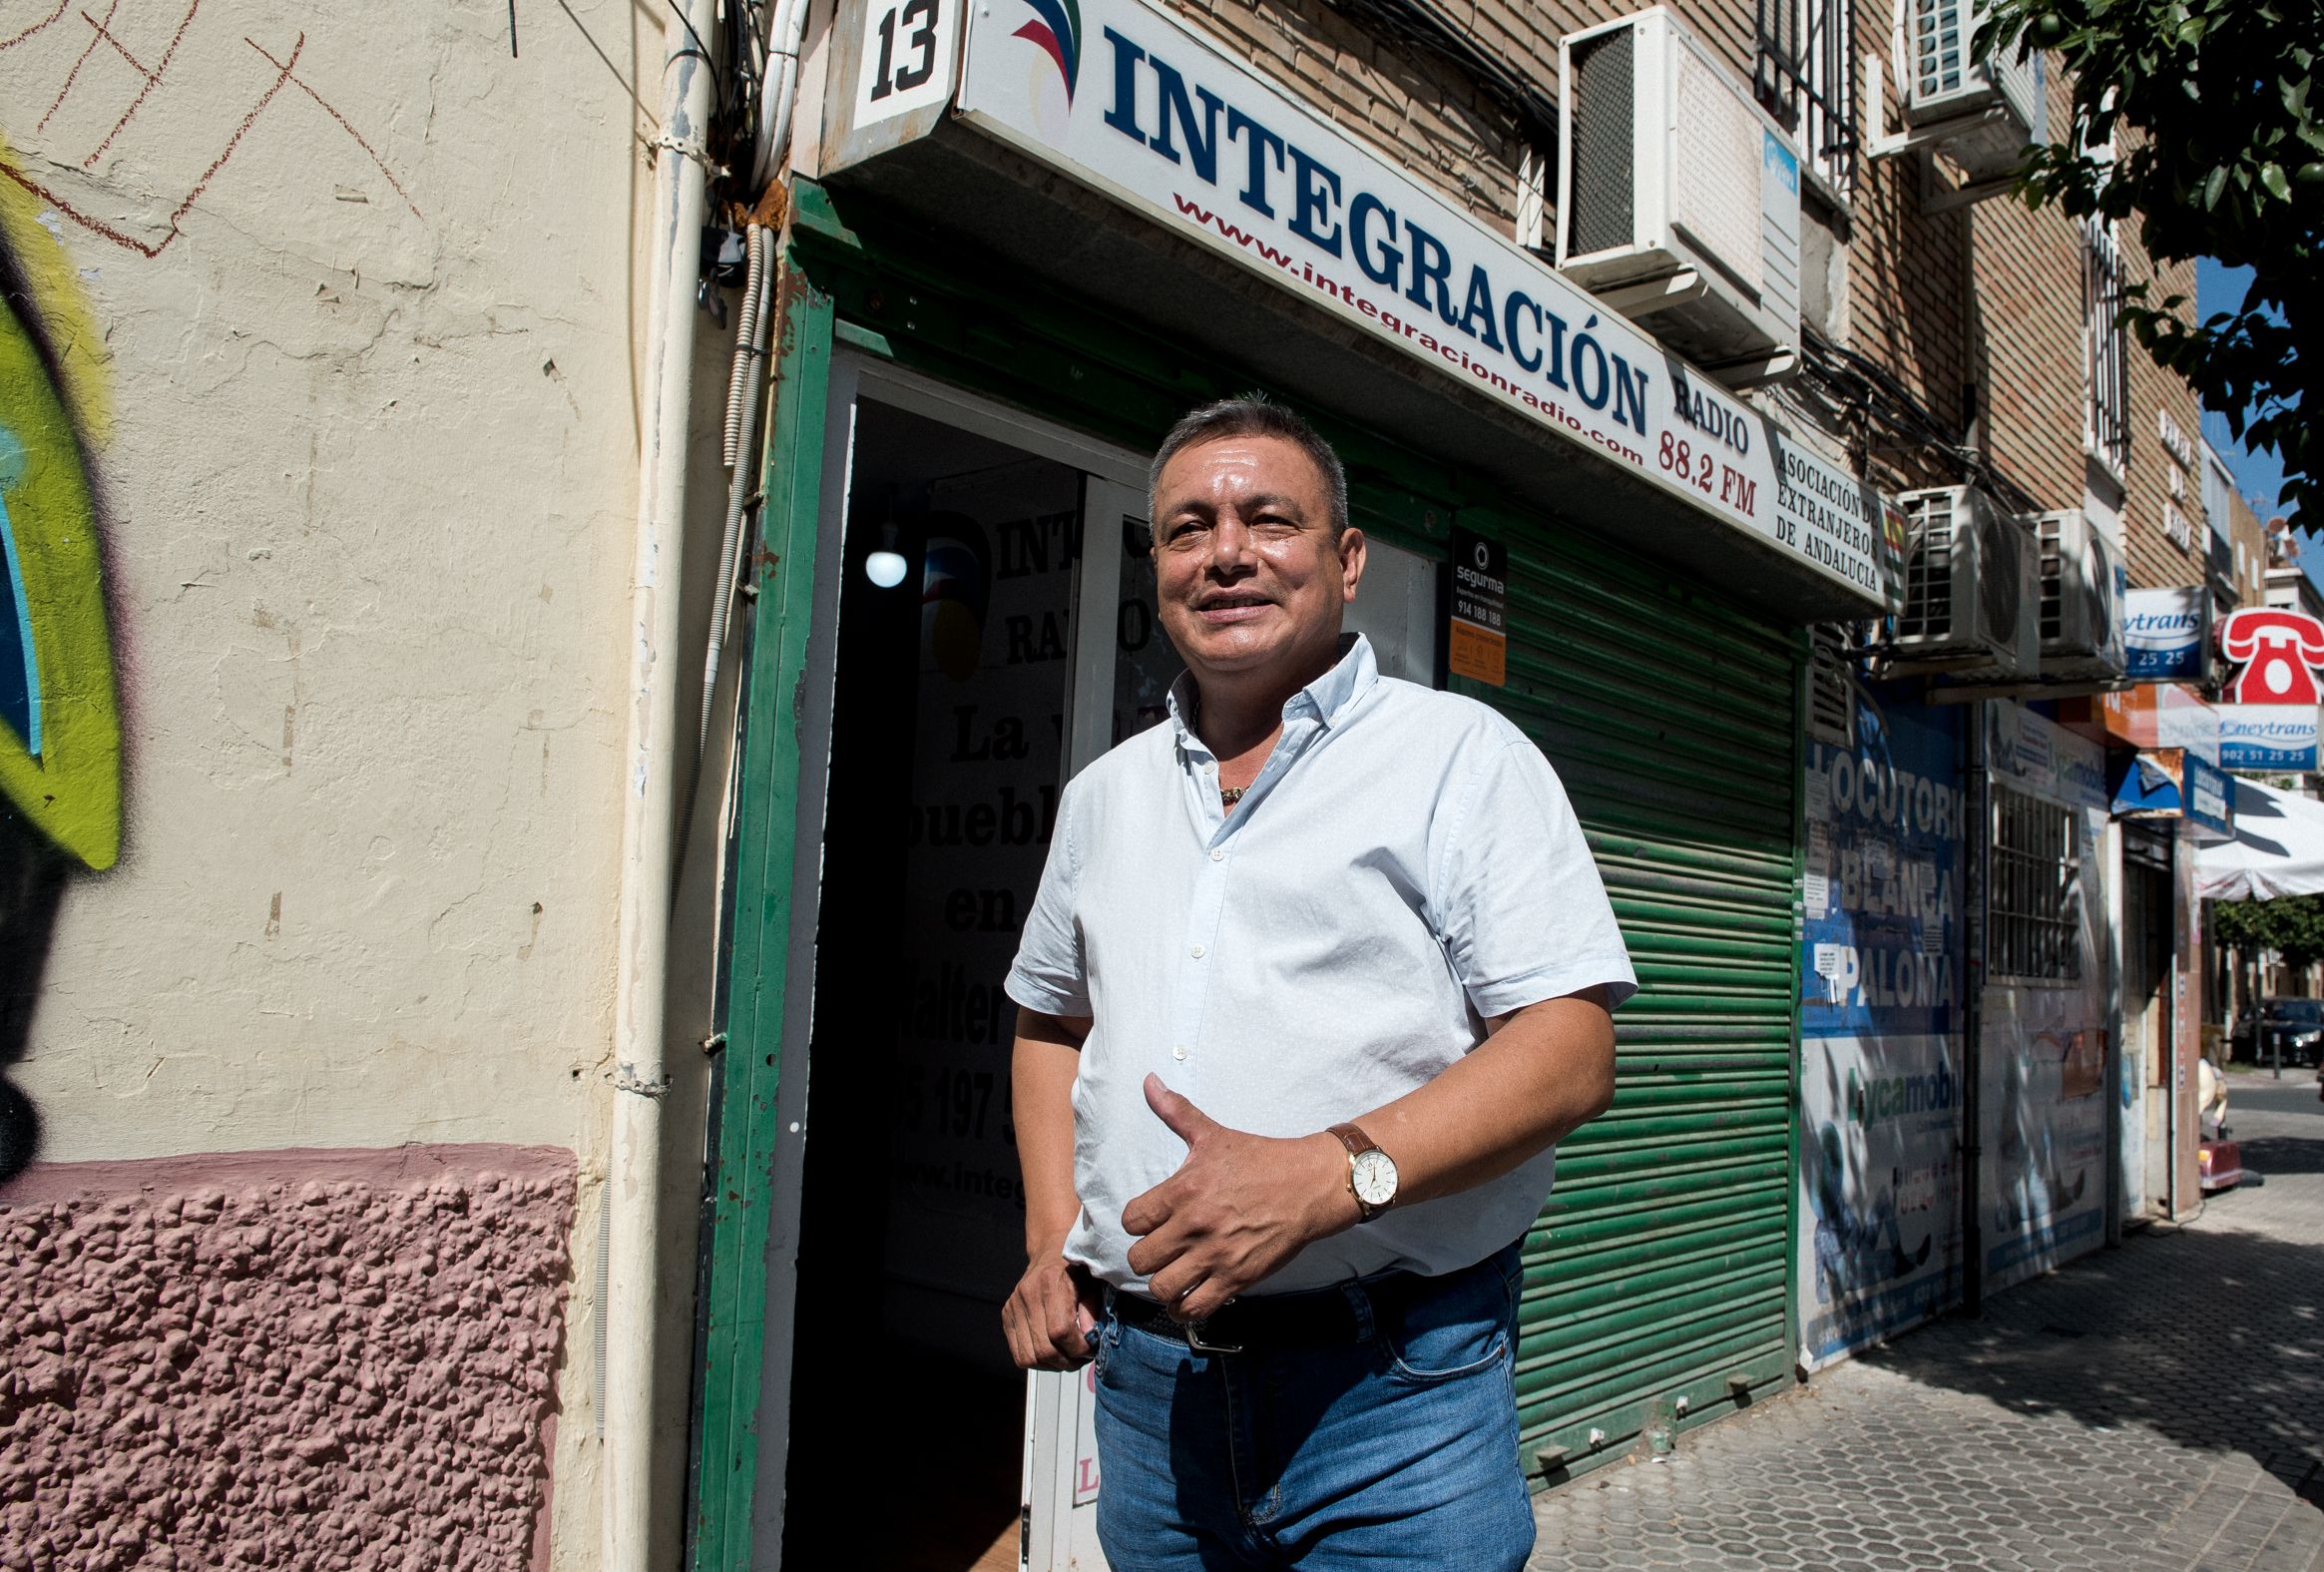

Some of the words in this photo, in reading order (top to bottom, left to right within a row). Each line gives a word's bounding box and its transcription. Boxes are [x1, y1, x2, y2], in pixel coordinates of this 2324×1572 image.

[871, 0, 939, 102] 13
[1104, 25, 1648, 437] INTEGRACIÓN
[1173, 192, 1642, 465] www.integracionradio.com
[1672, 375, 1749, 455] RADIO
[1659, 430, 1713, 494] 88.2
[1720, 464, 1757, 518] FM
[1778, 448, 1861, 518] ASOCIACIÓN
[1862, 501, 1879, 530] DE
[1776, 515, 1795, 547] DE
[1804, 533, 1877, 592] ANDALUCIA
[1777, 481, 1878, 561] EXTRANJEROS
[1457, 565, 1505, 595] segurma
[1458, 600, 1472, 616] 914
[1474, 605, 1487, 621] 188
[1489, 611, 1502, 627] 188
[2124, 612, 2201, 631] ytrans
[2138, 652, 2158, 667] 25
[2165, 651, 2185, 666] 25
[1837, 945, 1954, 1008] PALOMA
[1848, 1060, 1963, 1132] Lycamobil
